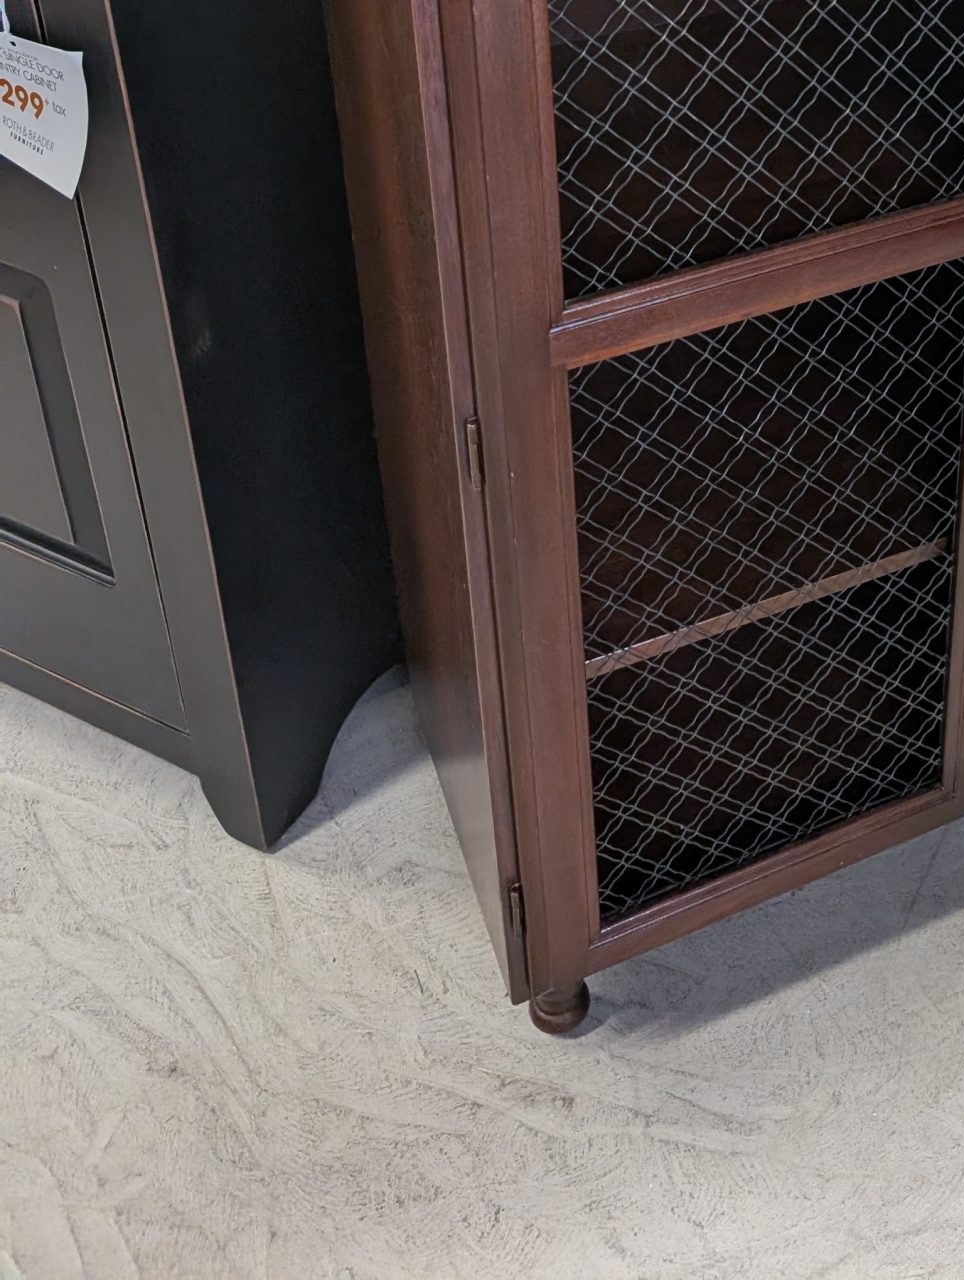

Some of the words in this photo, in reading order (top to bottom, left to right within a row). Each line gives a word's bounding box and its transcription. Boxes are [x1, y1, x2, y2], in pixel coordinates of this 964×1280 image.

[3, 50, 35, 70] SINGLE
[36, 62, 65, 82] DOOR
[23, 70, 57, 93] CABINET
[10, 131, 44, 156] FURNITURE
